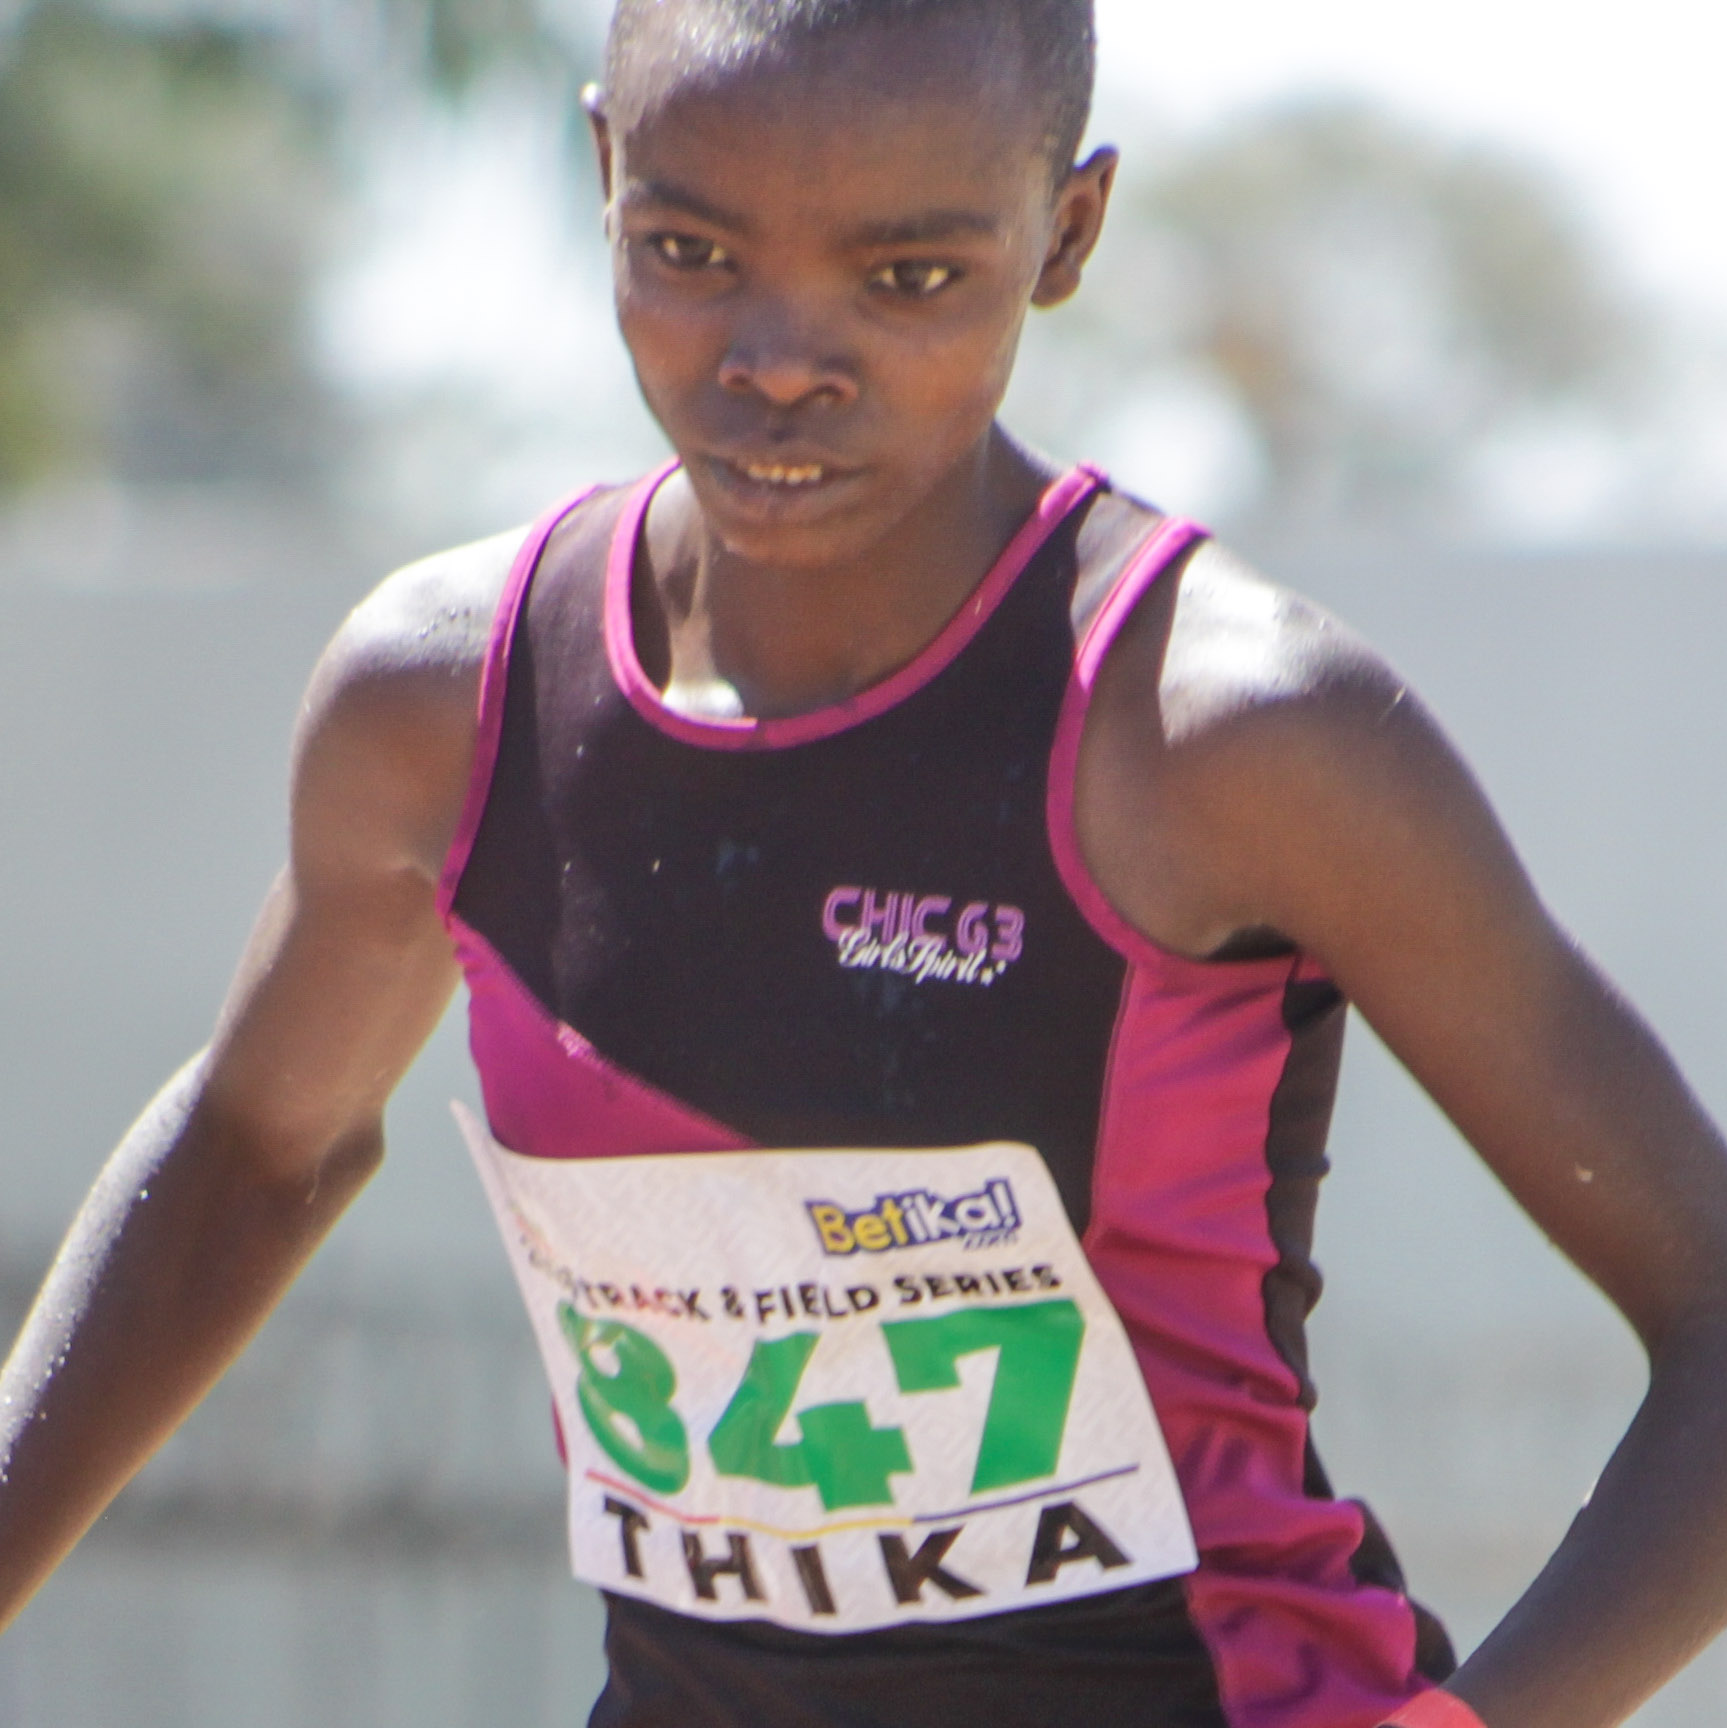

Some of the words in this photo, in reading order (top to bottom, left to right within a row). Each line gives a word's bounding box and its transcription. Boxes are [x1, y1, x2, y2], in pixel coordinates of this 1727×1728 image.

[822, 884, 952, 950] CHIC
[754, 1283, 880, 1325] FIELD
[894, 1263, 1063, 1305] SERIES
[556, 1299, 1087, 1512] 847
[602, 1495, 1134, 1617] THIKA
